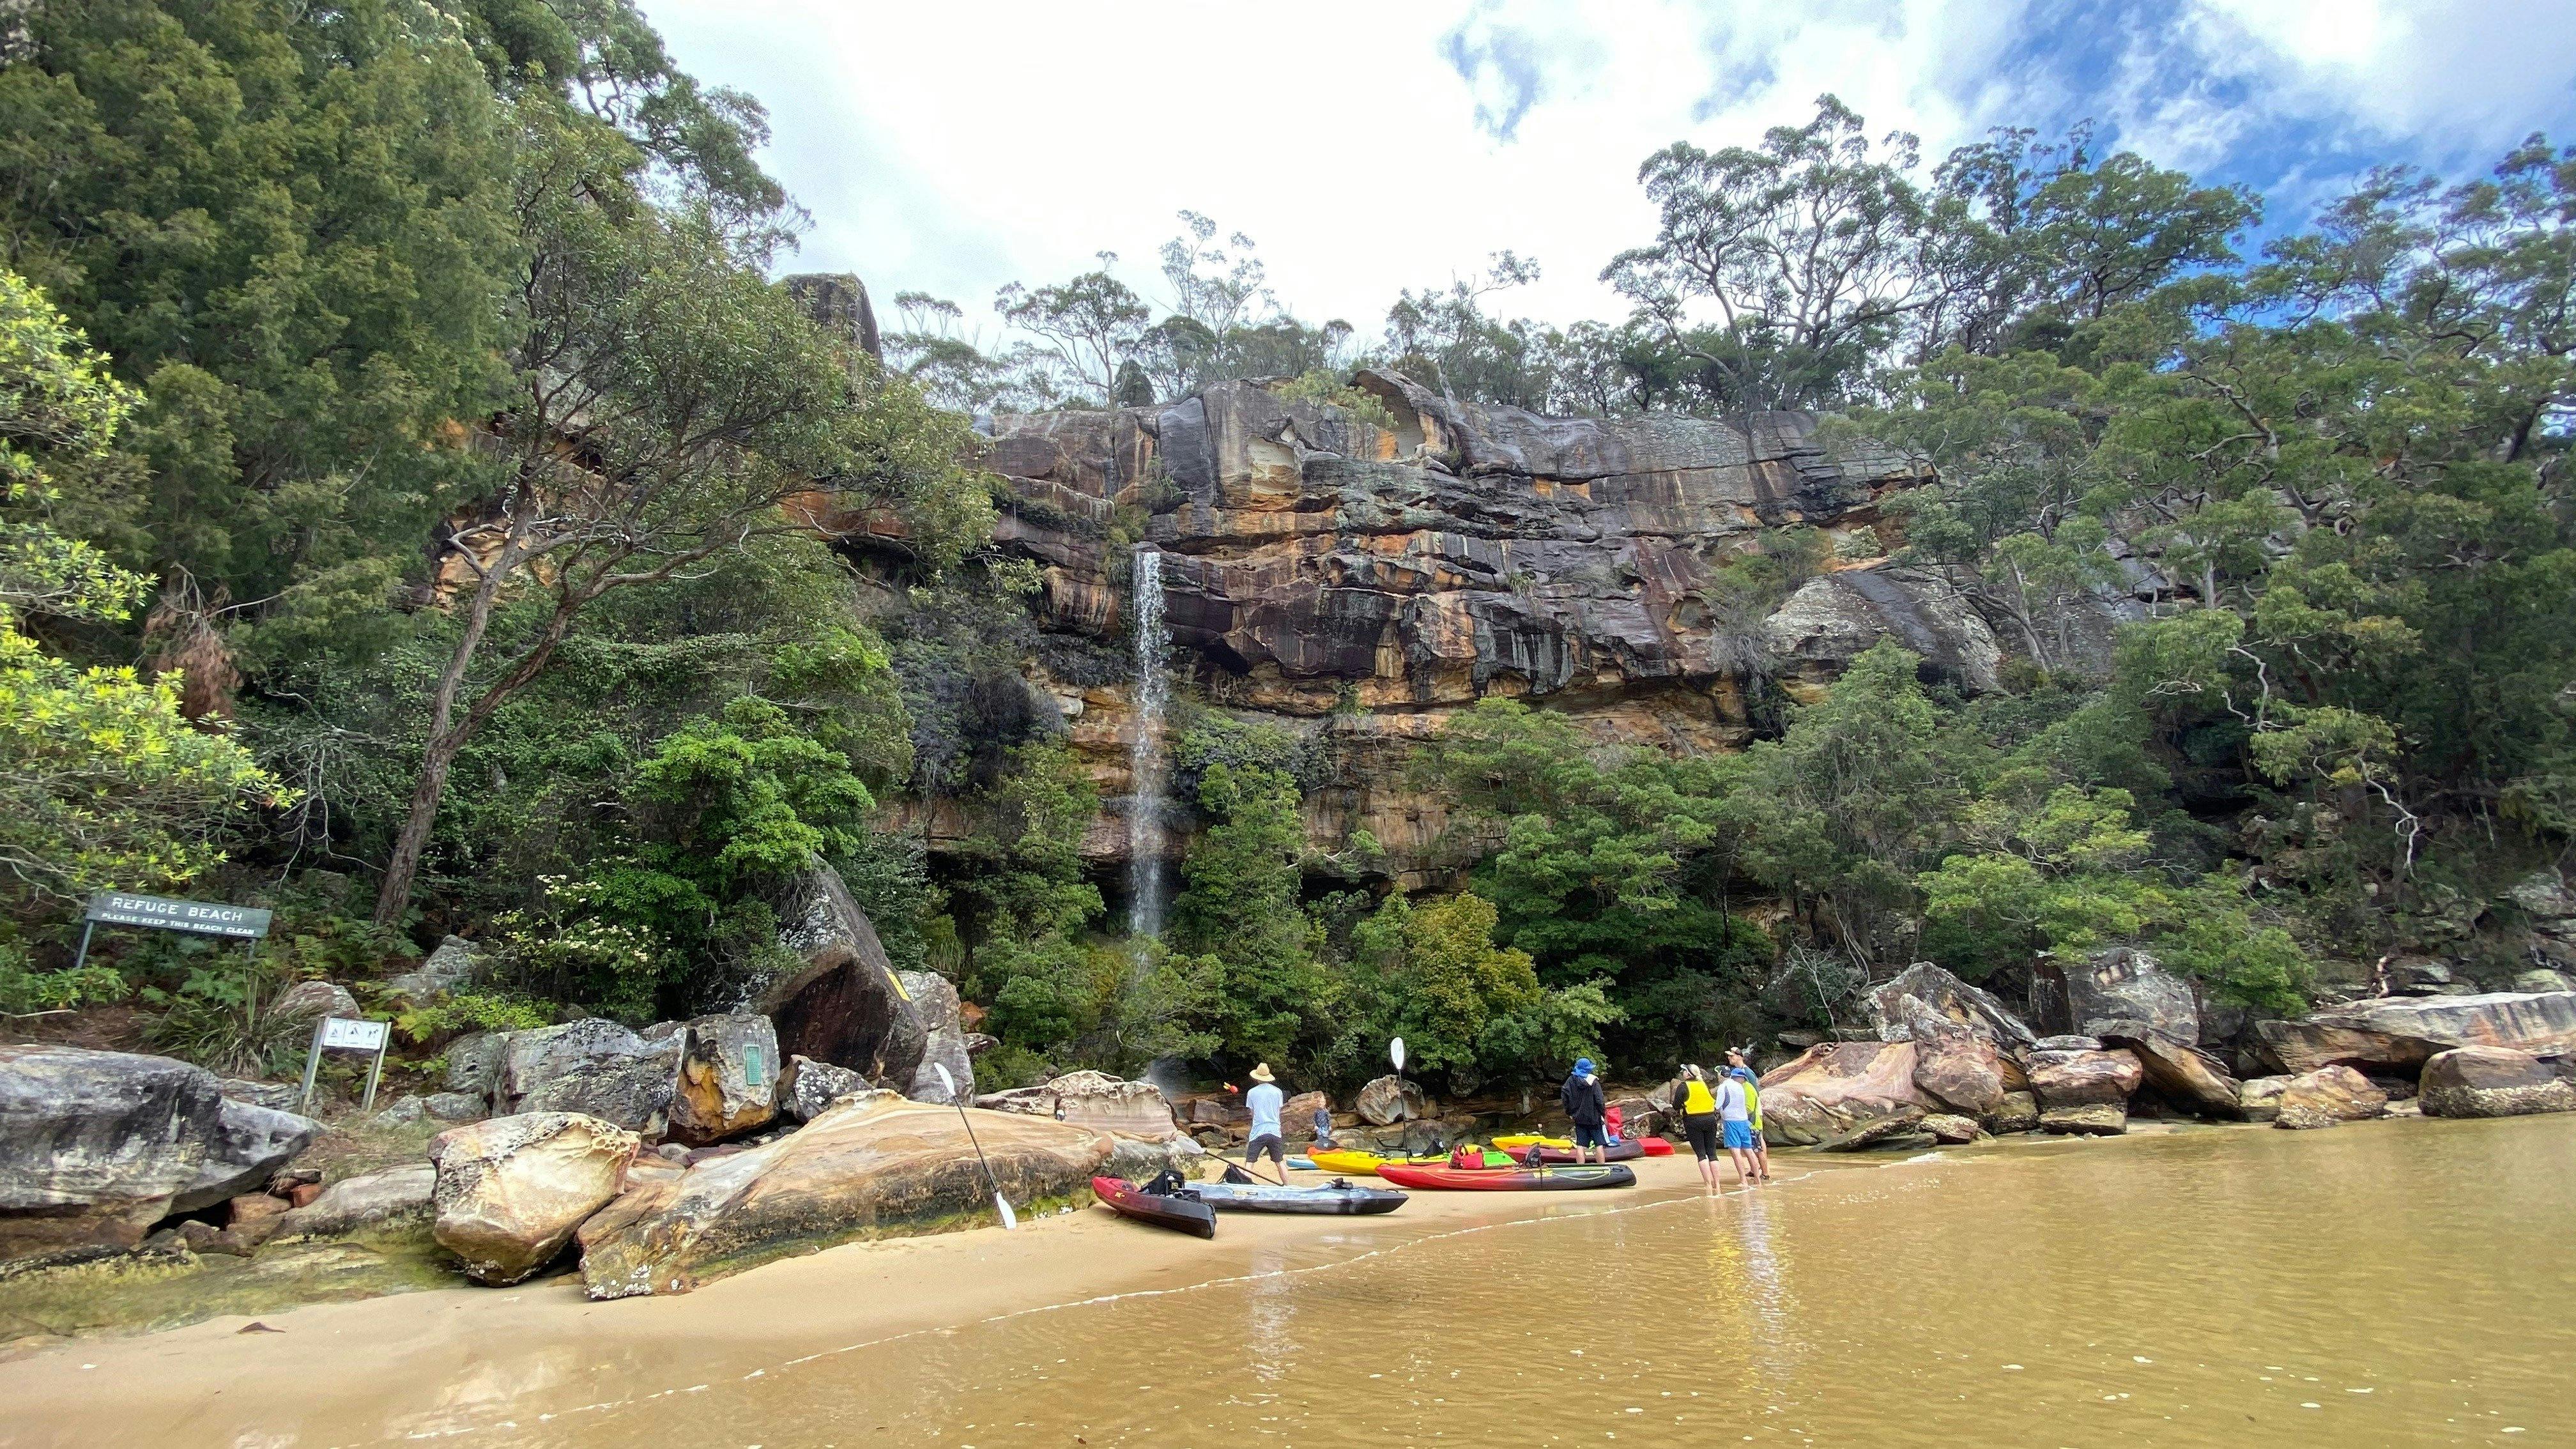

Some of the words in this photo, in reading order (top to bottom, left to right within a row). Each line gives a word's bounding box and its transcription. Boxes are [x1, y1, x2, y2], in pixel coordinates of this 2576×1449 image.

[111, 897, 180, 915] REFUGE
[188, 907, 243, 922] BEACH
[101, 912, 137, 922] PLEASE
[192, 923, 222, 931] BEACH
